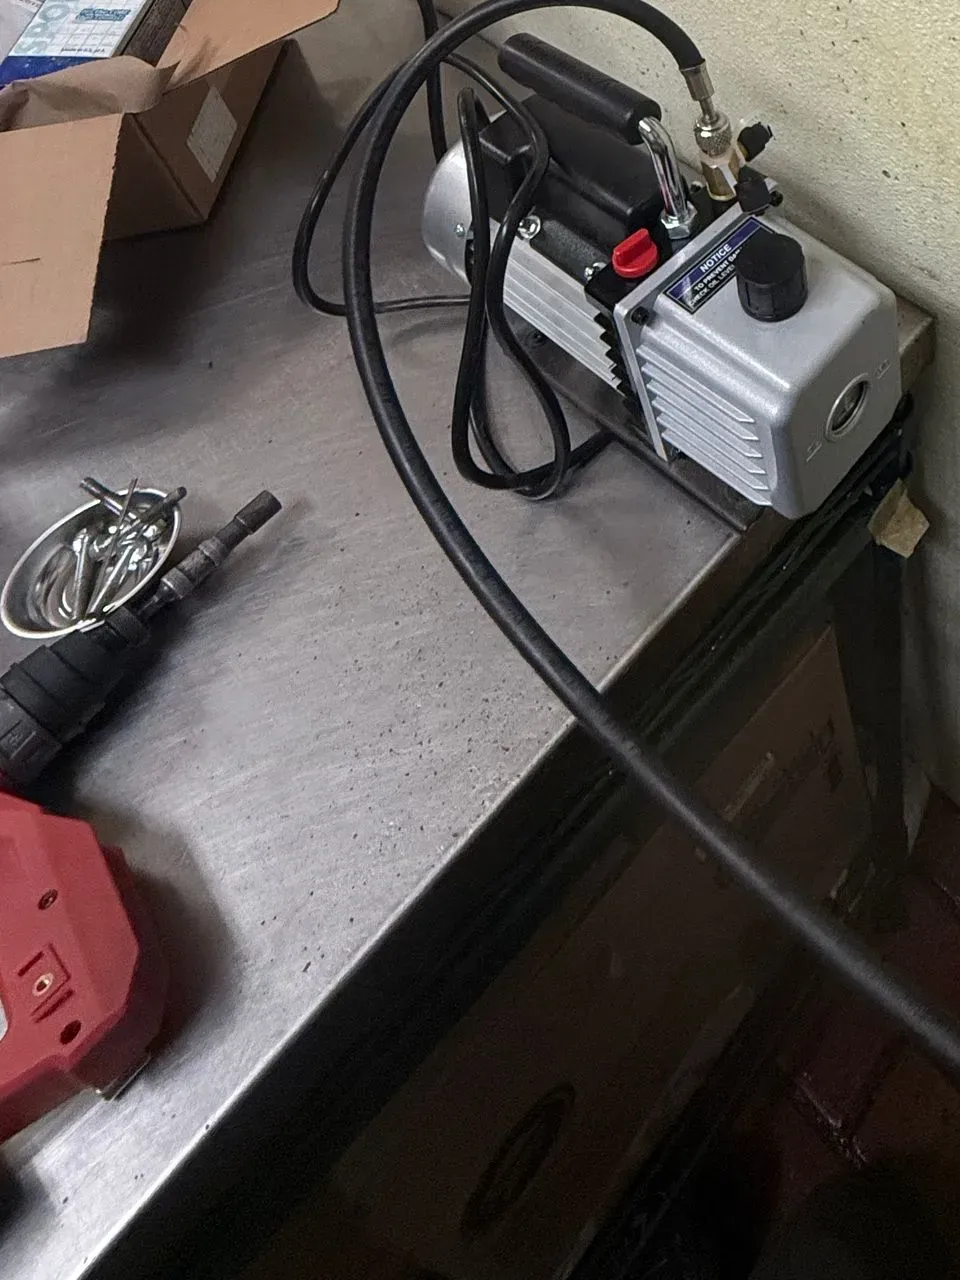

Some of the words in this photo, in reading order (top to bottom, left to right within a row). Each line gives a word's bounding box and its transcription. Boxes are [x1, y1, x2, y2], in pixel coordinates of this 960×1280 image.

[700, 243, 732, 273] NOTICE
[688, 288, 709, 307] CHECK
[709, 280, 720, 290] OIL
[718, 264, 735, 280] LEVE
[694, 282, 705, 292] TO
[704, 261, 730, 284] PREVENT
